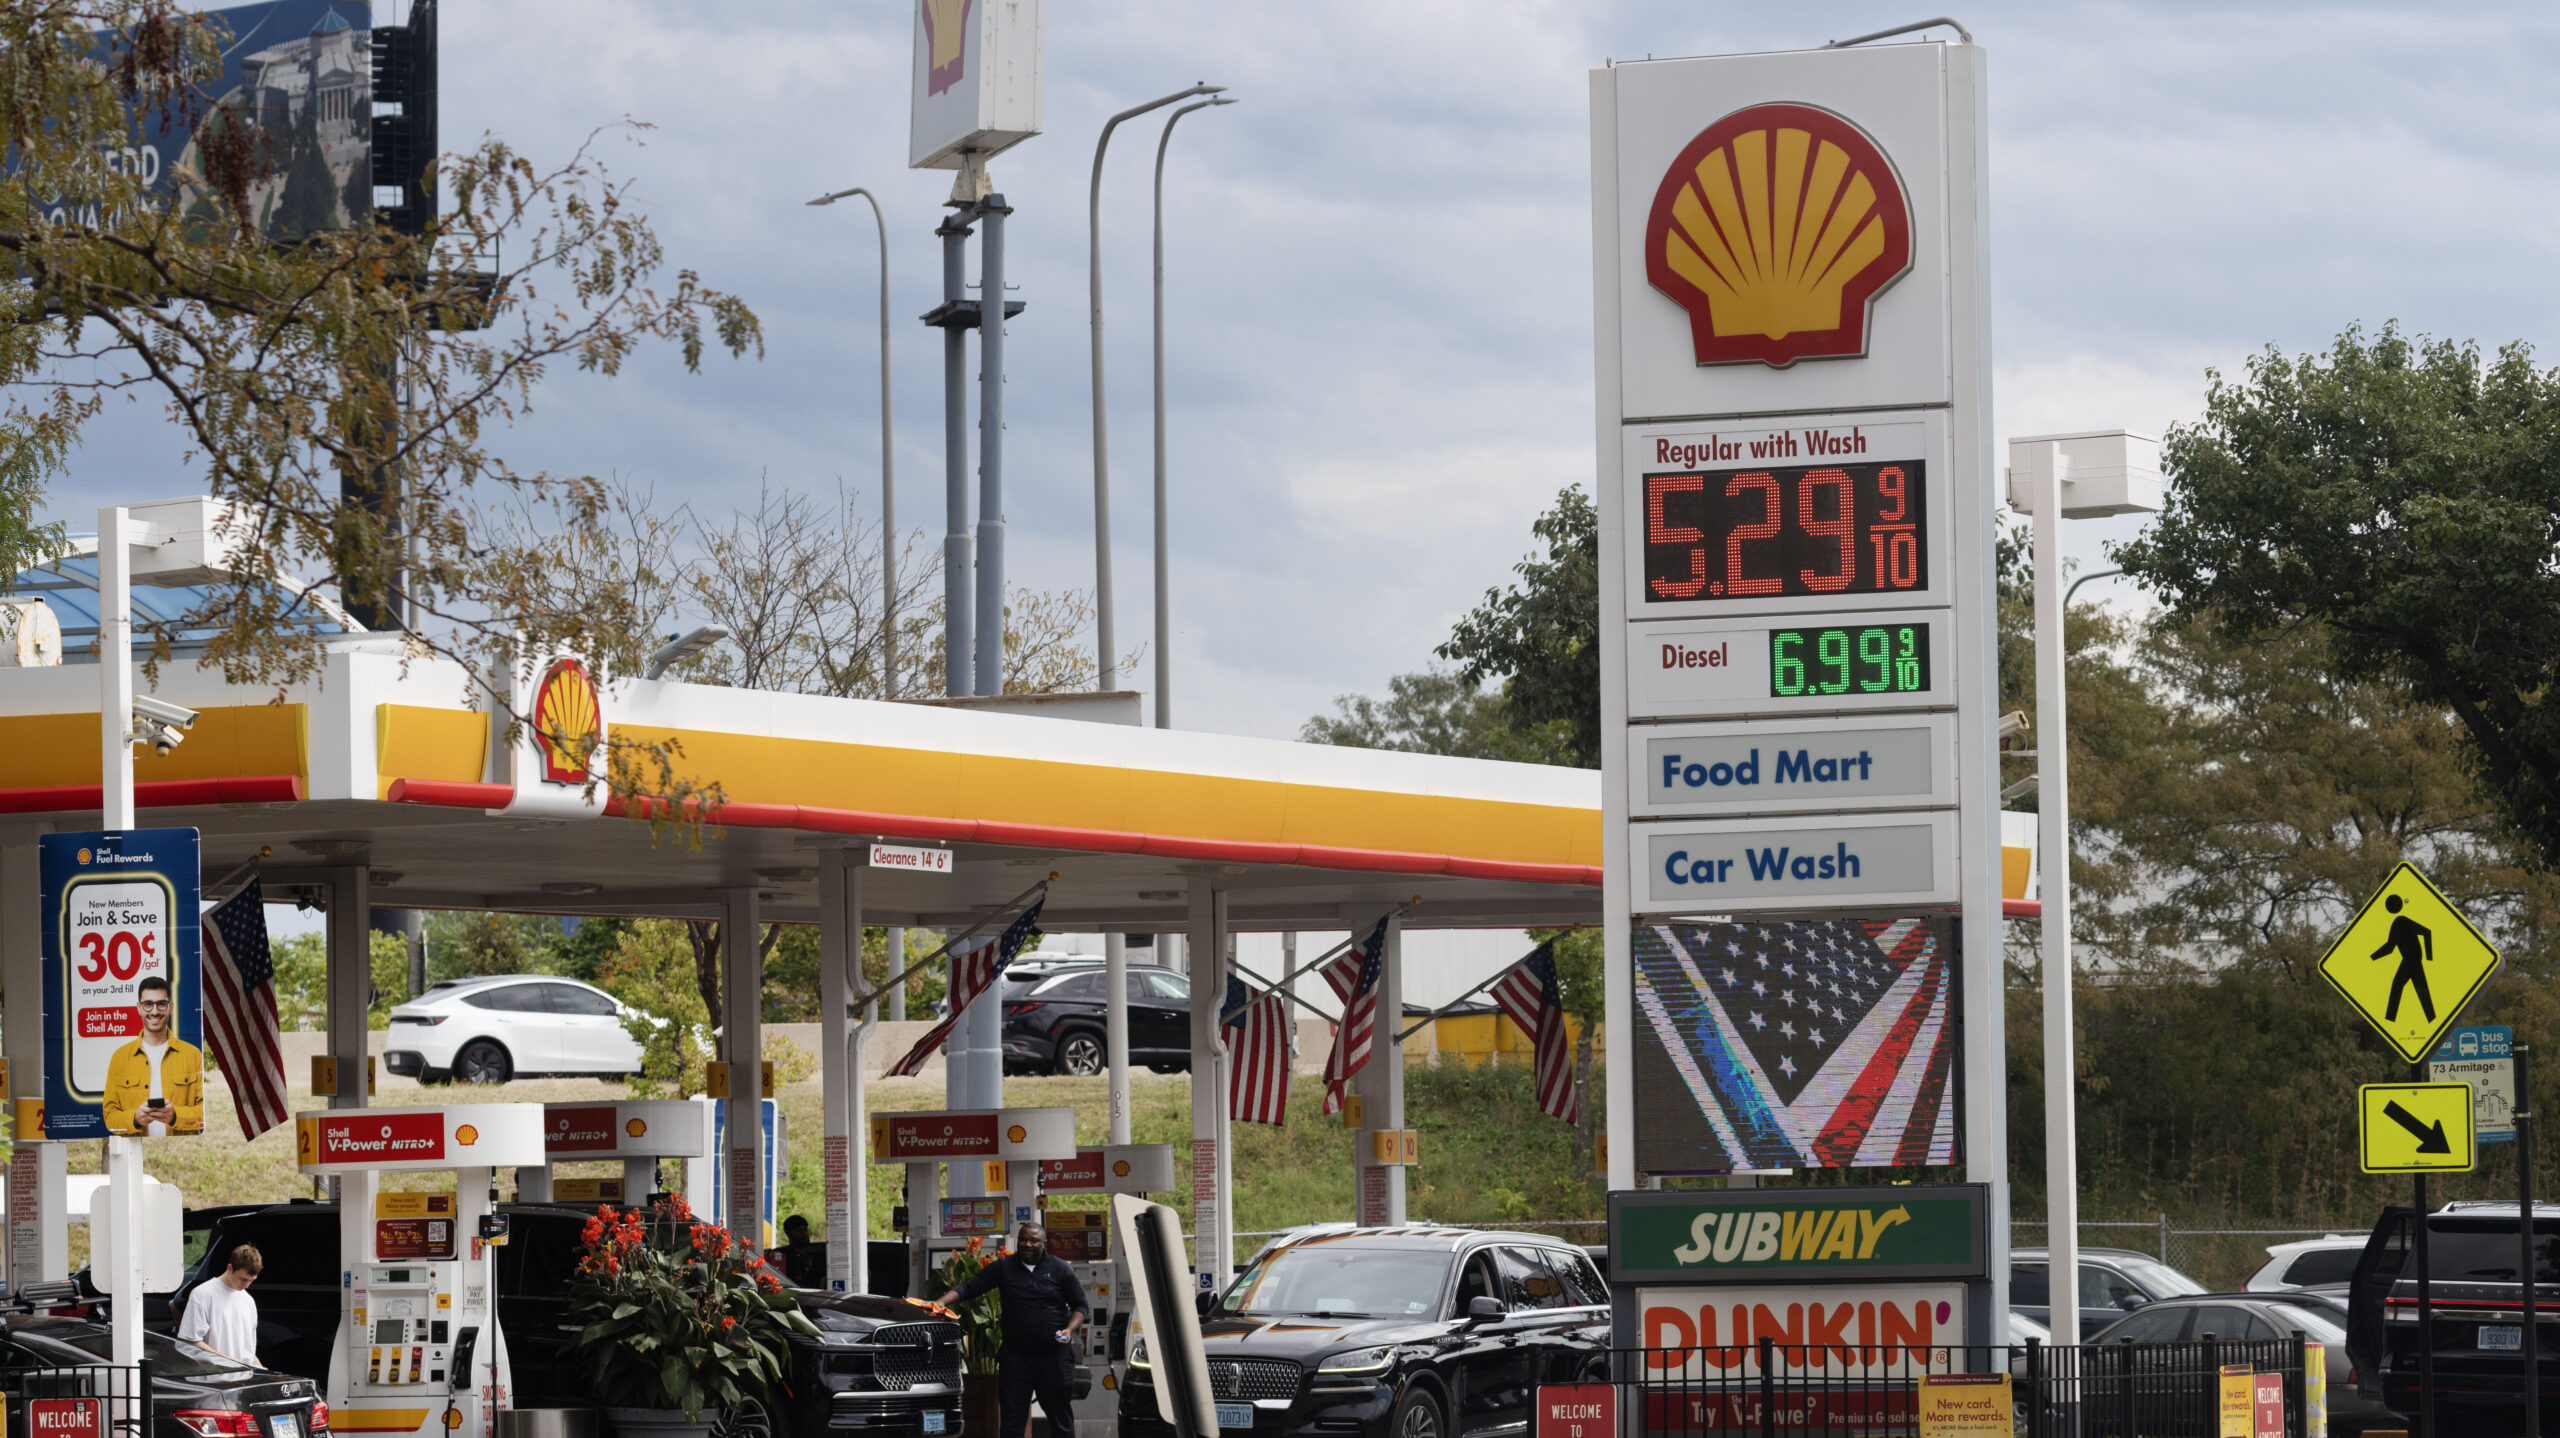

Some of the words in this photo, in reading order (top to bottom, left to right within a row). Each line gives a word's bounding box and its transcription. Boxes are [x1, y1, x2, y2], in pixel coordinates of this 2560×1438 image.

[1656, 434, 1742, 469] Regular
[1750, 430, 1797, 459] with
[1804, 427, 1866, 456] Wash
[1649, 469, 1855, 597] 5.29
[1662, 642, 1728, 669] Diesel
[1774, 629, 1890, 695] 6.99
[1662, 748, 1760, 788] Food
[1774, 749, 1873, 784] Mart
[96, 855, 113, 864] Fuel
[114, 852, 154, 863] Rewards
[873, 847, 917, 866] Clearance
[1665, 850, 1734, 885] Car
[1745, 842, 1861, 881] Wash
[88, 900, 106, 908] New
[108, 899, 144, 908] Members
[77, 911, 102, 927] Join
[106, 911, 118, 925] &
[122, 910, 157, 925] Save
[93, 987, 108, 996] your
[110, 985, 124, 994] 3rd
[125, 984, 134, 993] fill
[85, 1011, 102, 1022] Join
[103, 1011, 111, 1020] in
[113, 1010, 127, 1020] the
[86, 1023, 105, 1033] Shell
[107, 1023, 126, 1034] App
[2481, 1031, 2504, 1042] bus
[2481, 1042, 2509, 1055] stop
[326, 1068, 333, 1083] 5
[2433, 1064, 2446, 1073] 73
[2448, 1062, 2496, 1074] Armitage
[719, 1074, 725, 1087] 7
[763, 1073, 770, 1087] 8
[327, 1127, 350, 1138] Shell
[875, 1129, 884, 1149] 7
[897, 1127, 917, 1136] Shell
[301, 1131, 311, 1154] 2
[327, 1138, 387, 1152] V-Power
[897, 1136, 949, 1147] V-Power
[1385, 1138, 1393, 1157] 9
[1405, 1138, 1415, 1157] 10
[989, 1165, 1000, 1182] 11
[1673, 1204, 1911, 1267] SUBWAY
[2257, 1387, 2280, 1404] WELCOME
[1937, 1399, 1963, 1410] New
[1967, 1397, 1995, 1409] card.
[1243, 1412, 1251, 1423] LY
[1551, 1404, 1602, 1419] WELCOME
[1926, 1411, 1955, 1422] More
[1958, 1409, 2007, 1422] rewards.
[2266, 1410, 2273, 1425] TO
[38, 1411, 92, 1428] WELCOME
[1570, 1425, 1583, 1438] TO
